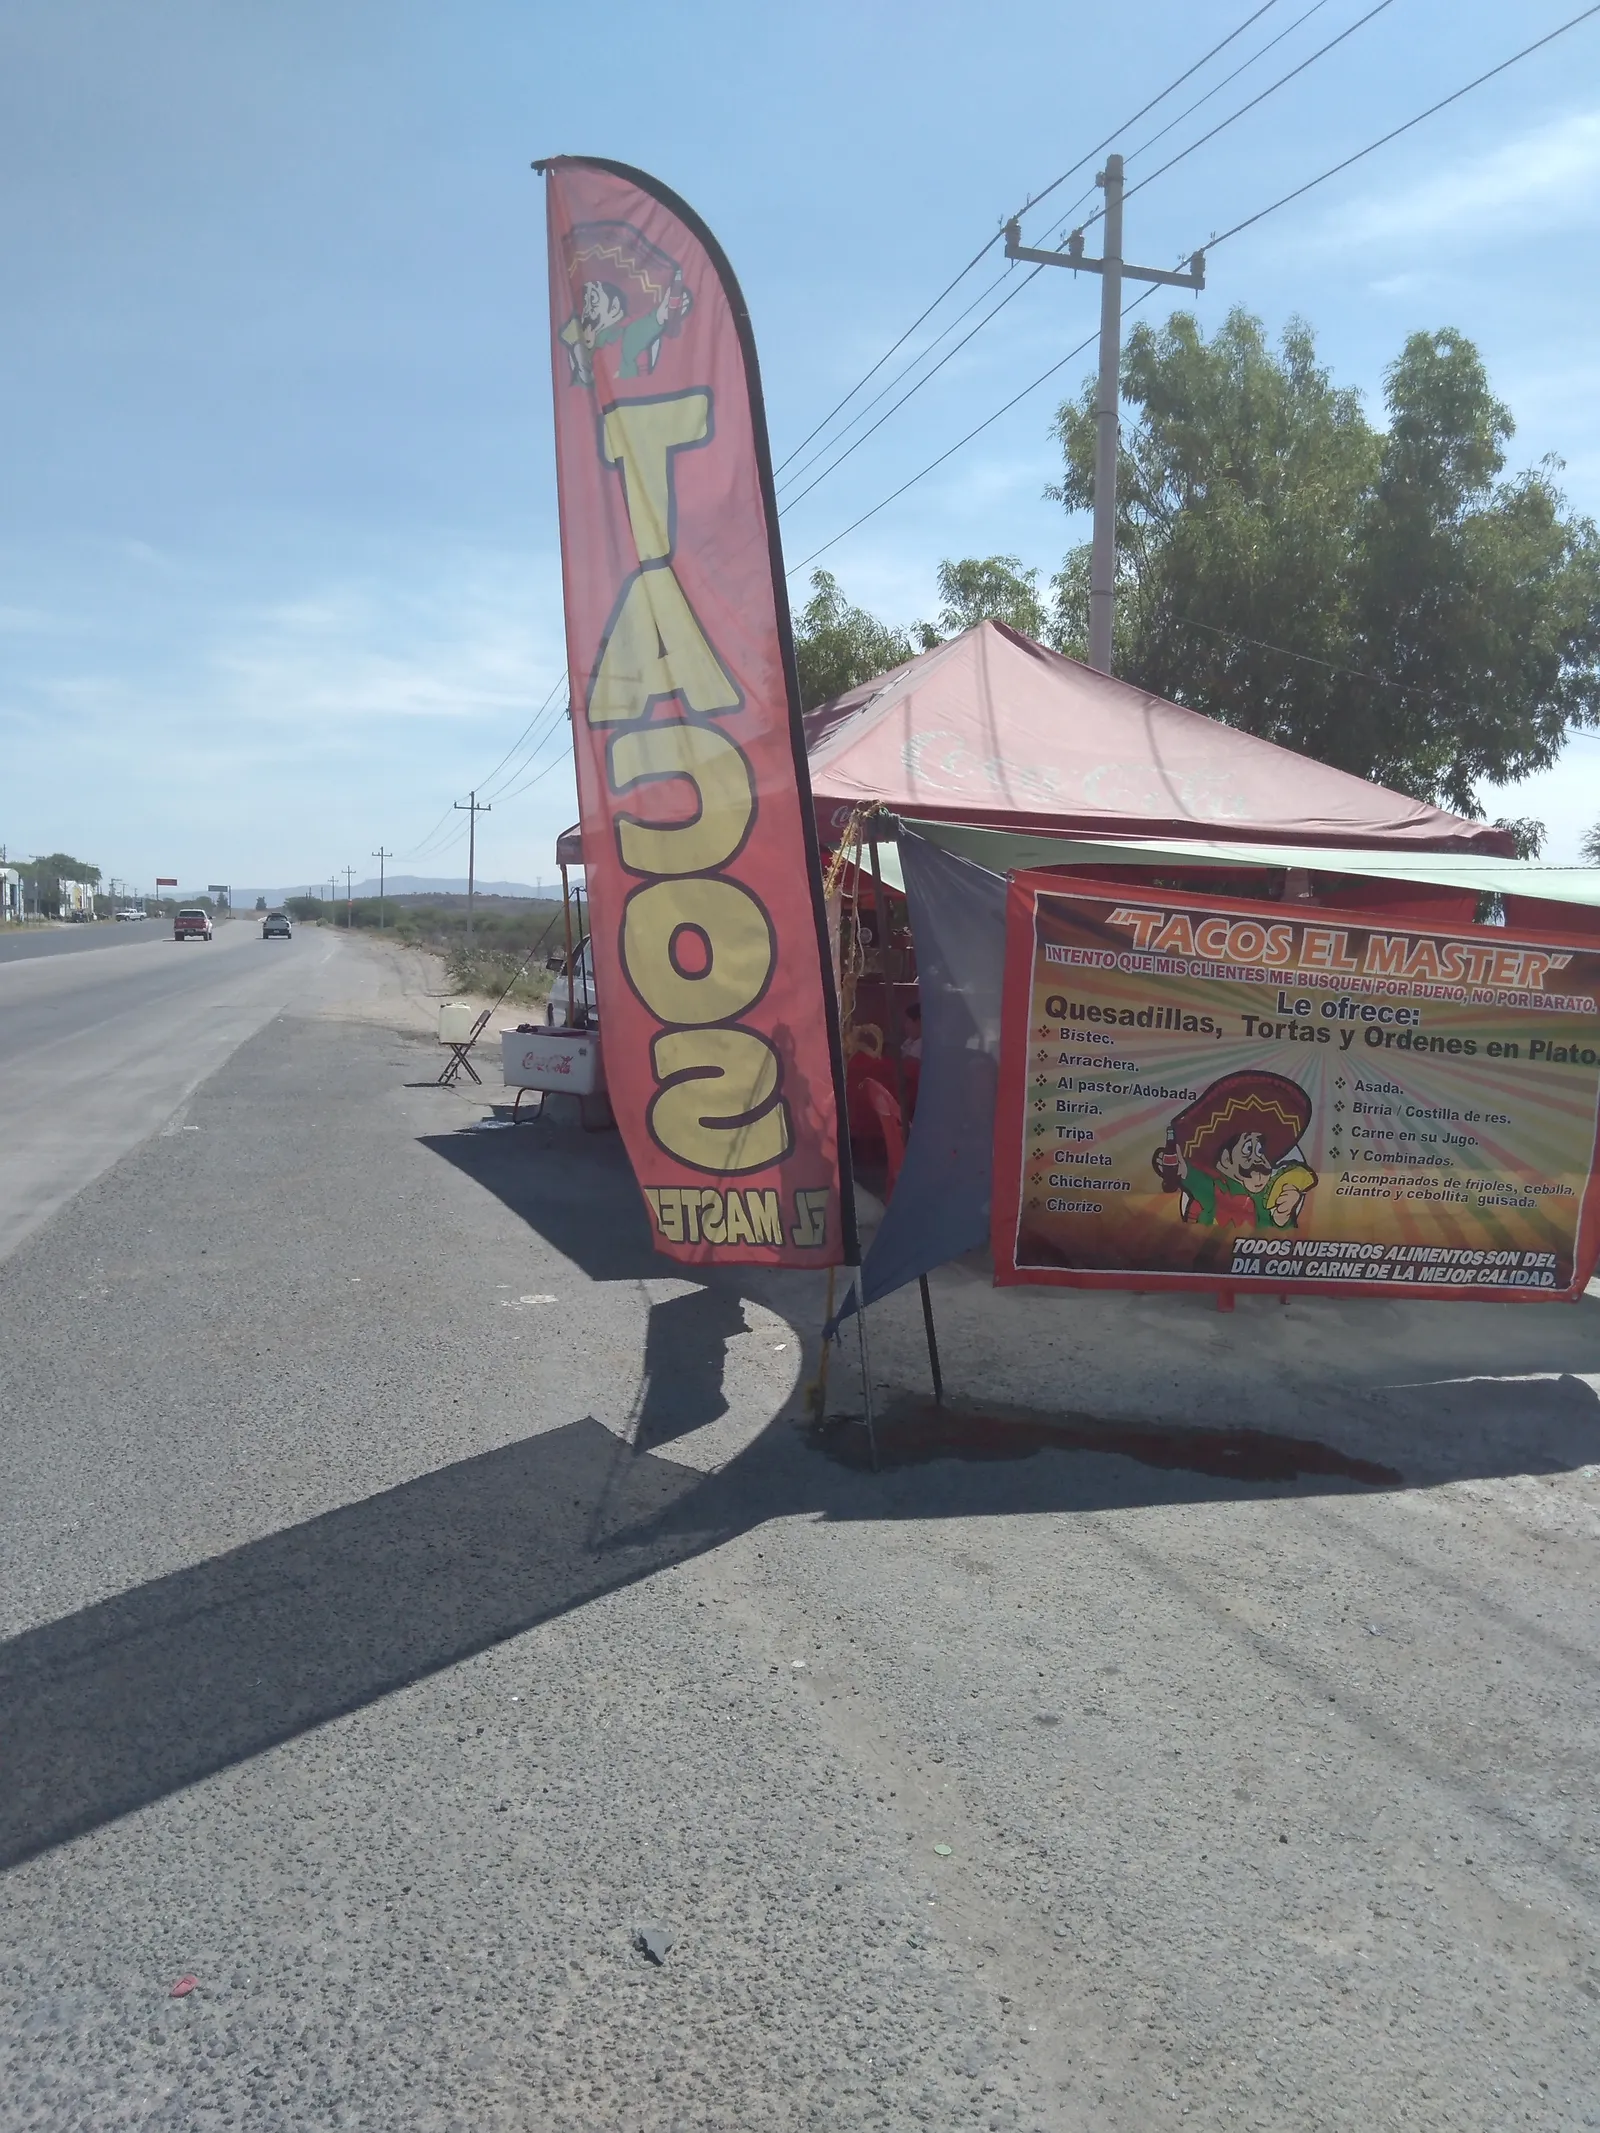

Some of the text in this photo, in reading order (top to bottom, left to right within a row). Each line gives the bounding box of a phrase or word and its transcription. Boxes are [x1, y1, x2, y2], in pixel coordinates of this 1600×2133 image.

[1299, 928, 1357, 972] EL
[1045, 944, 1597, 1014] INTENTO QUE MIS CLIENTES ME BUSQUEN POR BUENO, NO POR BARATO.
[1277, 989, 1420, 1026] Le ofrece:
[1044, 995, 1223, 1039] Quesadillas,
[1241, 1014, 1331, 1044] Tortas
[1339, 1027, 1355, 1051] y
[1364, 1025, 1477, 1056] Ordenes
[1487, 1040, 1519, 1059] en
[1059, 1027, 1114, 1045] Bistec.
[1058, 1052, 1140, 1072] Arrachera.
[1057, 1076, 1197, 1101] Al pastor/Adobada
[1354, 1079, 1404, 1095] Asada.
[1056, 1099, 1102, 1115] Birria.
[1352, 1102, 1392, 1117] Birria
[1405, 1105, 1460, 1121] Costilla
[1464, 1110, 1481, 1122] de
[1484, 1113, 1511, 1125] res.
[1055, 1126, 1094, 1142] Tripa
[1351, 1126, 1479, 1147] Carne en su Jugo.
[1054, 1150, 1112, 1166] Chuleta
[1349, 1149, 1454, 1167] Y Combinados.
[1048, 1175, 1131, 1191] Chicharrón
[1339, 1171, 1439, 1187] Acompañados
[1443, 1176, 1461, 1189] de
[1465, 1178, 1518, 1194] frijoles,
[1046, 1198, 1102, 1213] Chorizo
[1335, 1185, 1538, 1208] cilantro y cebollita guisada.
[1232, 1239, 1557, 1268] TODOS NUESTROS ALIMENTOS SON DEL
[1231, 1258, 1557, 1287] DIA CON CARNE DE LA MEJOR CALIDAD.
